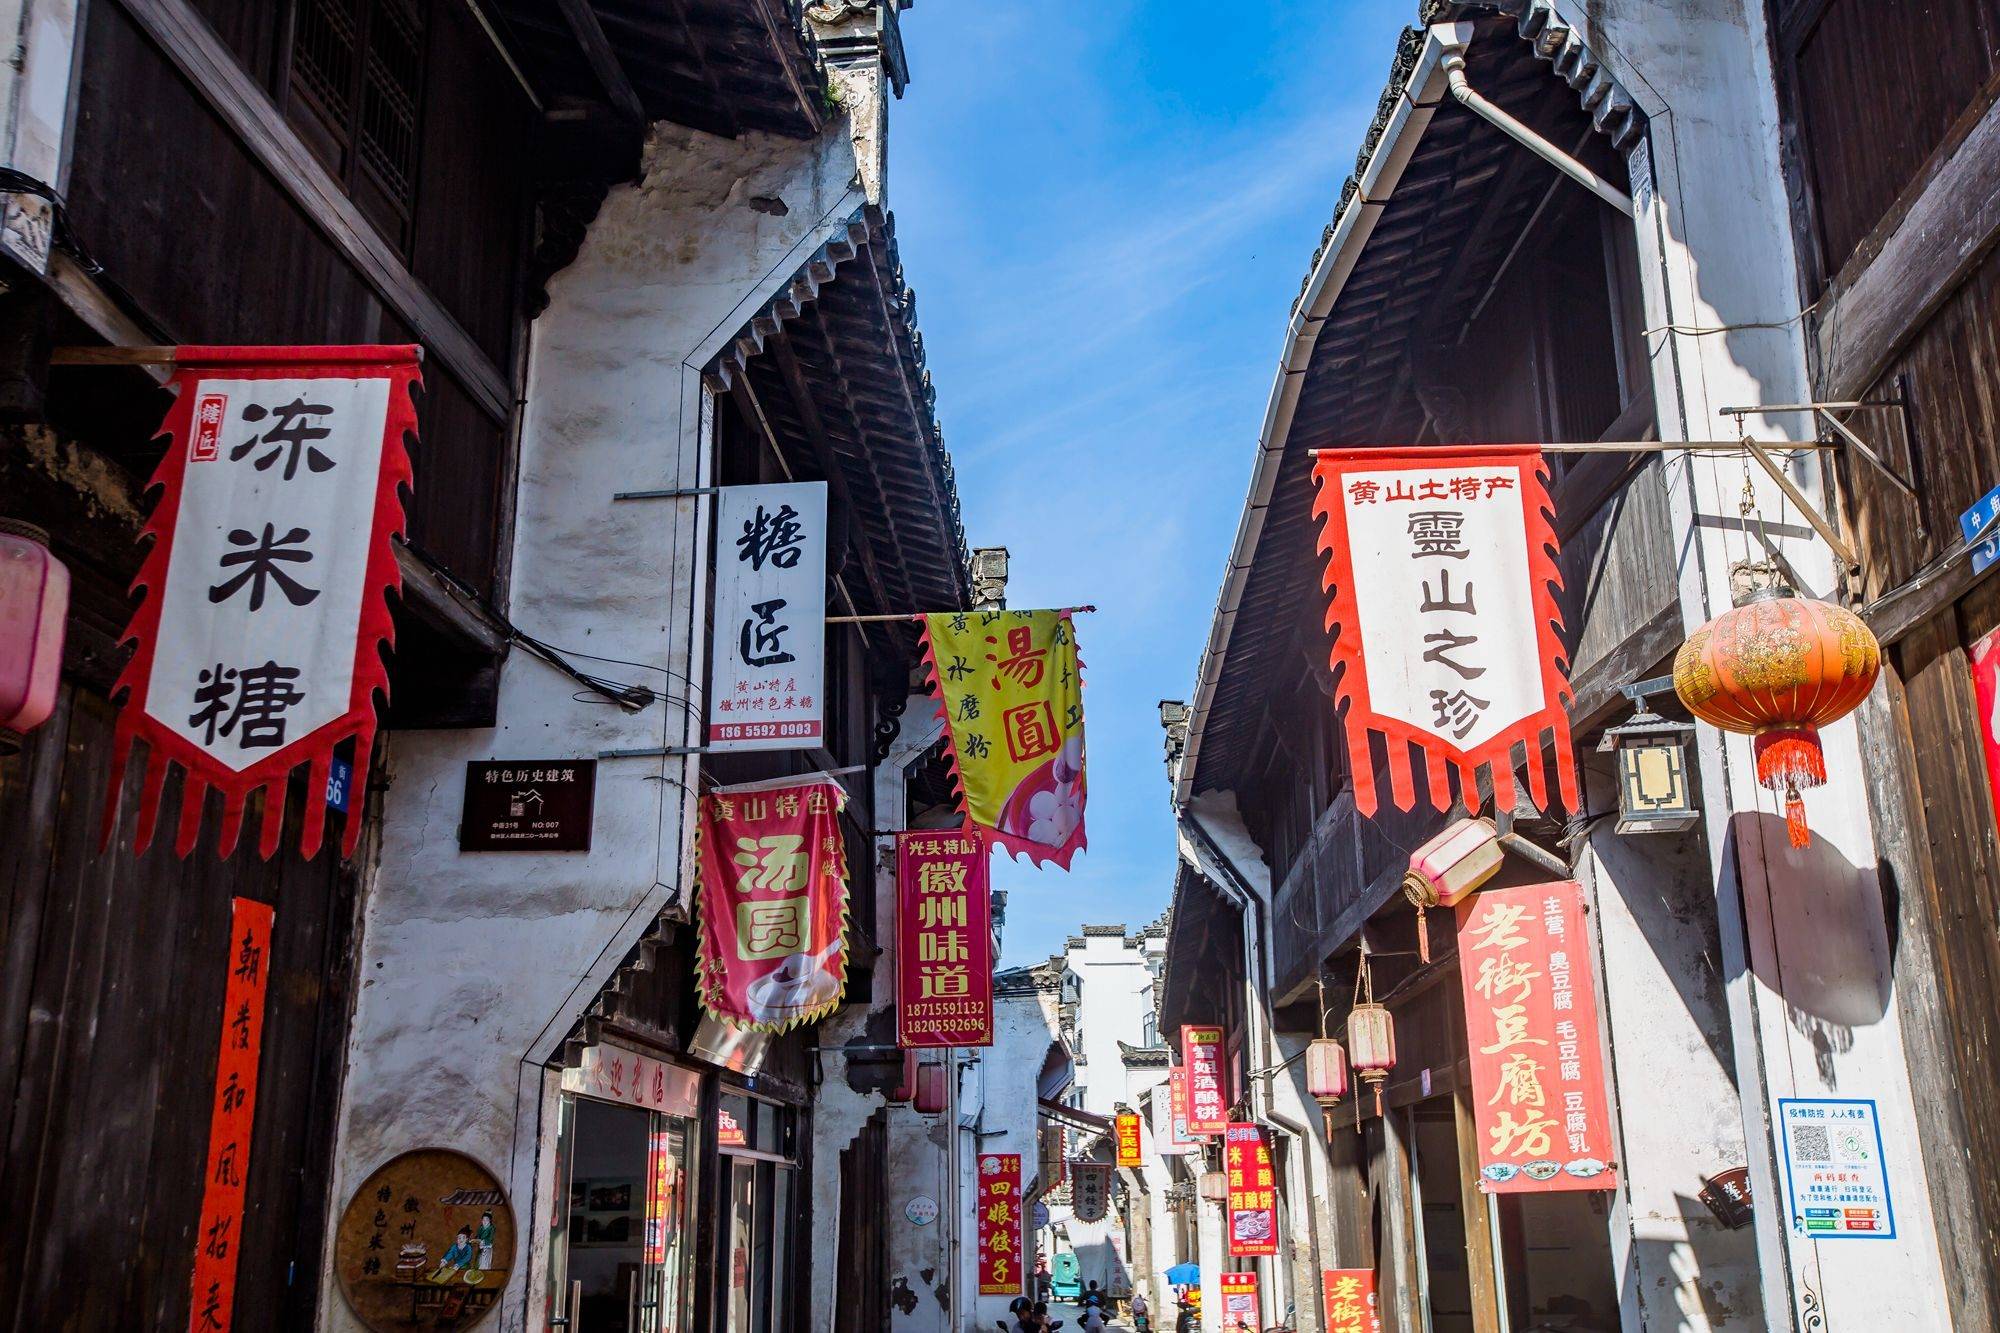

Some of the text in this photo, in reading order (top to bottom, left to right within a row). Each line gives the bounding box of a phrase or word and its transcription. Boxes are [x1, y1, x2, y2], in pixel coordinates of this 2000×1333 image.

[1349, 476, 1514, 504] 黄山土特产
[189, 398, 336, 748] 冻米糖
[736, 504, 806, 668] 糖匠
[947, 610, 1033, 636] 黄山
[1408, 511, 1490, 739] 靈山之珍
[719, 696, 813, 711] 徽州特色米糖
[947, 655, 992, 760] 水磨粉
[745, 724, 776, 737] 5592
[780, 723, 811, 735] 0903
[485, 769, 575, 783] 特色历史建筑
[713, 792, 829, 823] 黄山特色
[734, 834, 812, 962] 汤圆
[918, 861, 970, 998] 徽州味道
[1549, 951, 1573, 1010] 臭豆腐
[907, 1001, 985, 1017] 18715591132
[907, 1018, 985, 1033] 18205592696
[1469, 903, 1560, 1157] 老街豆腐坊
[1556, 1021, 1581, 1080] 毛豆腐
[1563, 1092, 1590, 1153] 豆腐乳
[1789, 1108, 1865, 1119] 疫情防控 人人有责
[1120, 1116, 1138, 1158] 雅士民宿
[1230, 1169, 1272, 1187] 酒酿
[1231, 1191, 1273, 1210] 酒酿饼
